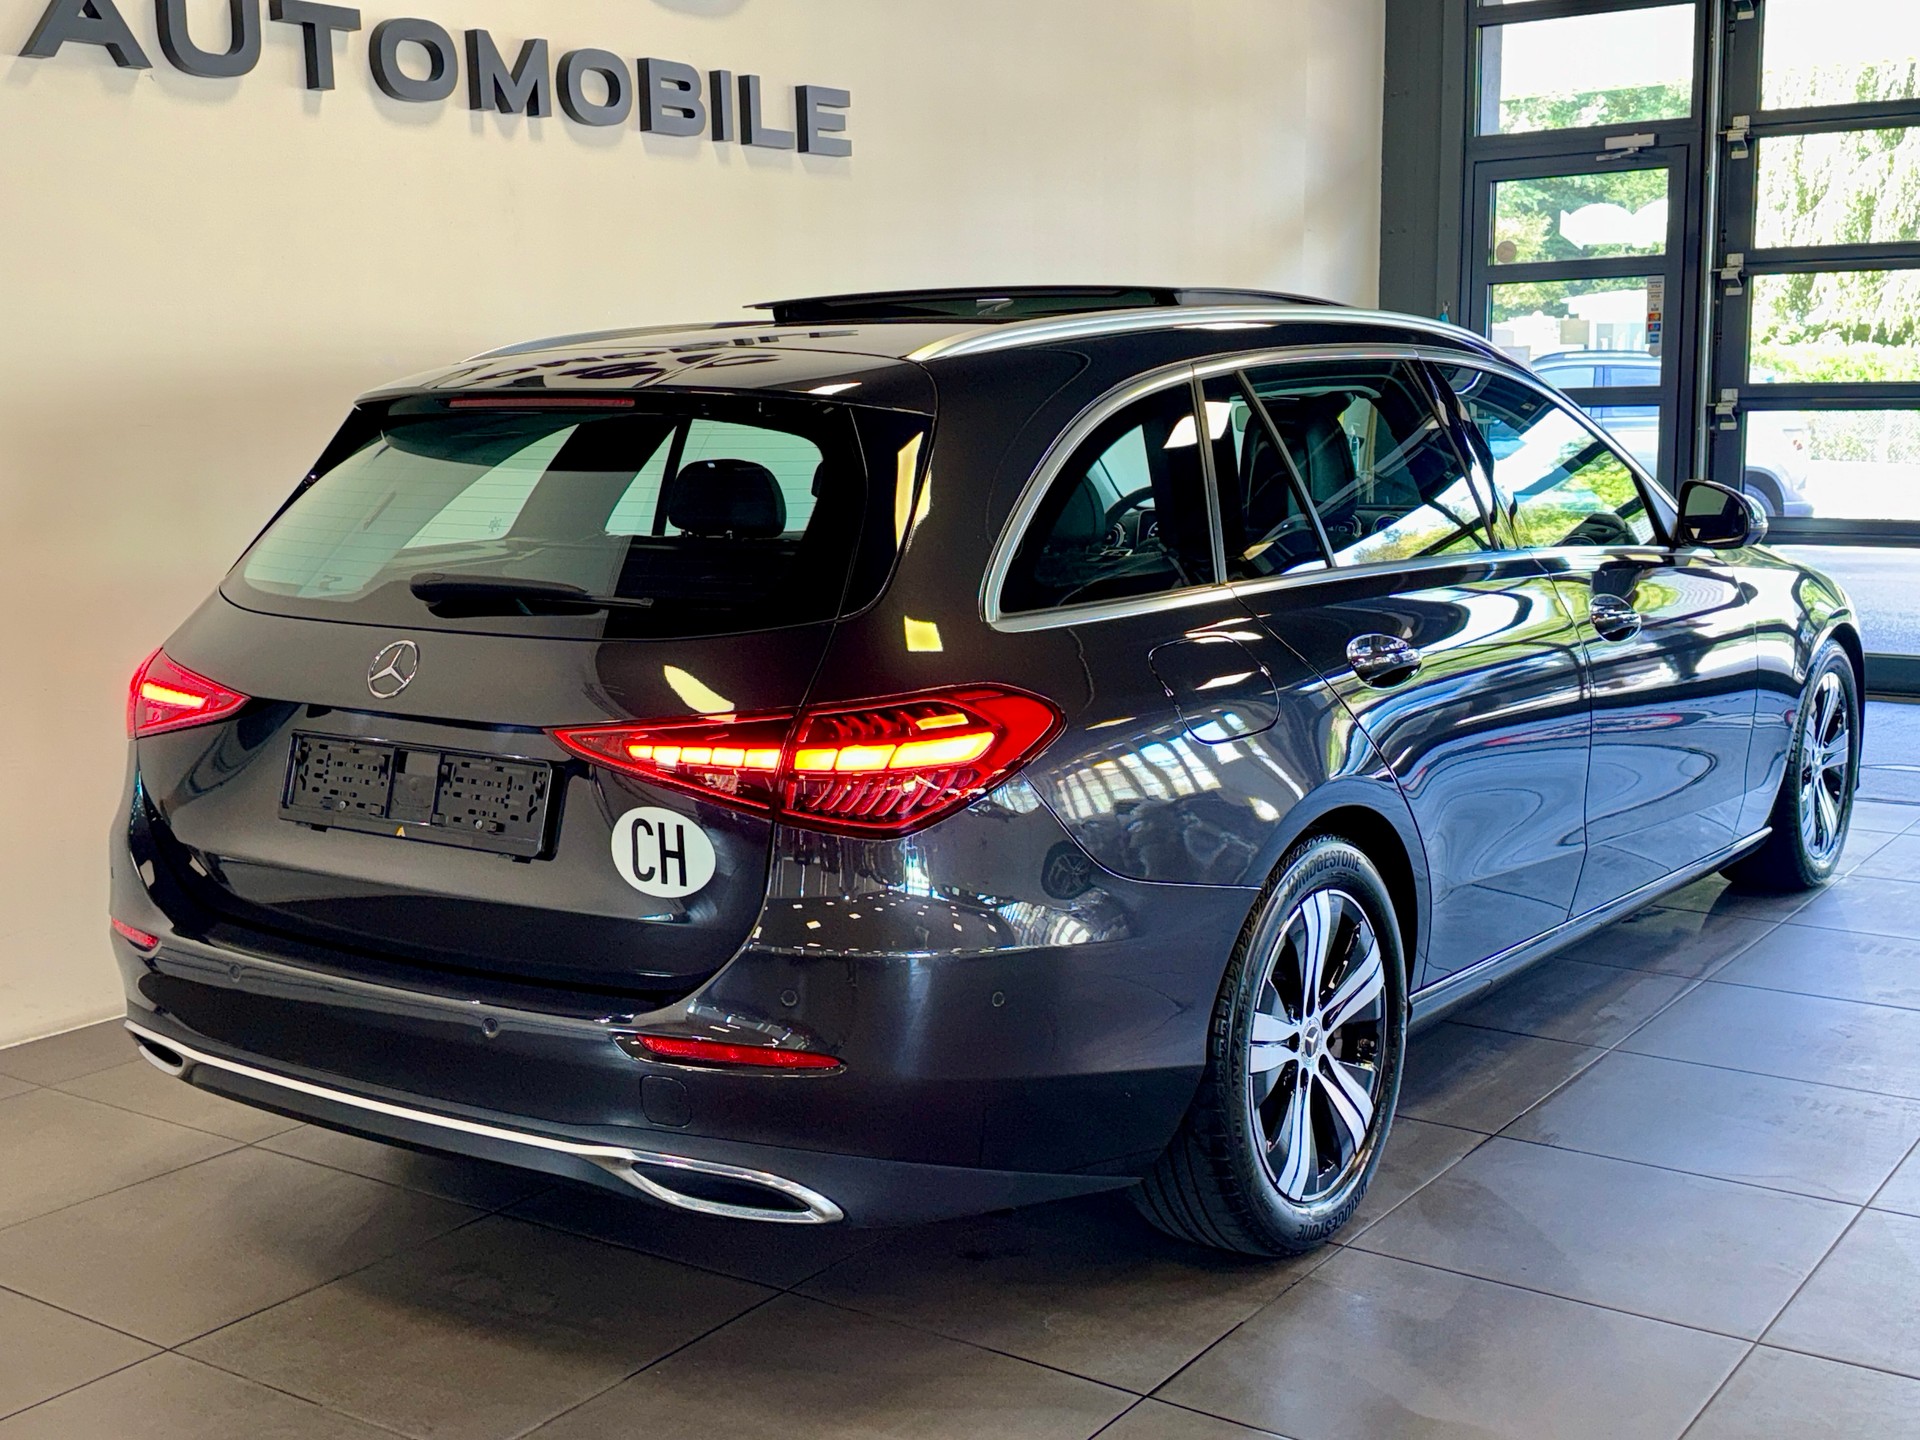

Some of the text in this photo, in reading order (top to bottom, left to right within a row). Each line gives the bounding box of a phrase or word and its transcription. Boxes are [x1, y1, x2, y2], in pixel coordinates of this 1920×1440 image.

[18, 0, 853, 157] AUTOMOBILE
[631, 818, 688, 887] CH
[1286, 849, 1362, 900] BRIDGESTONE
